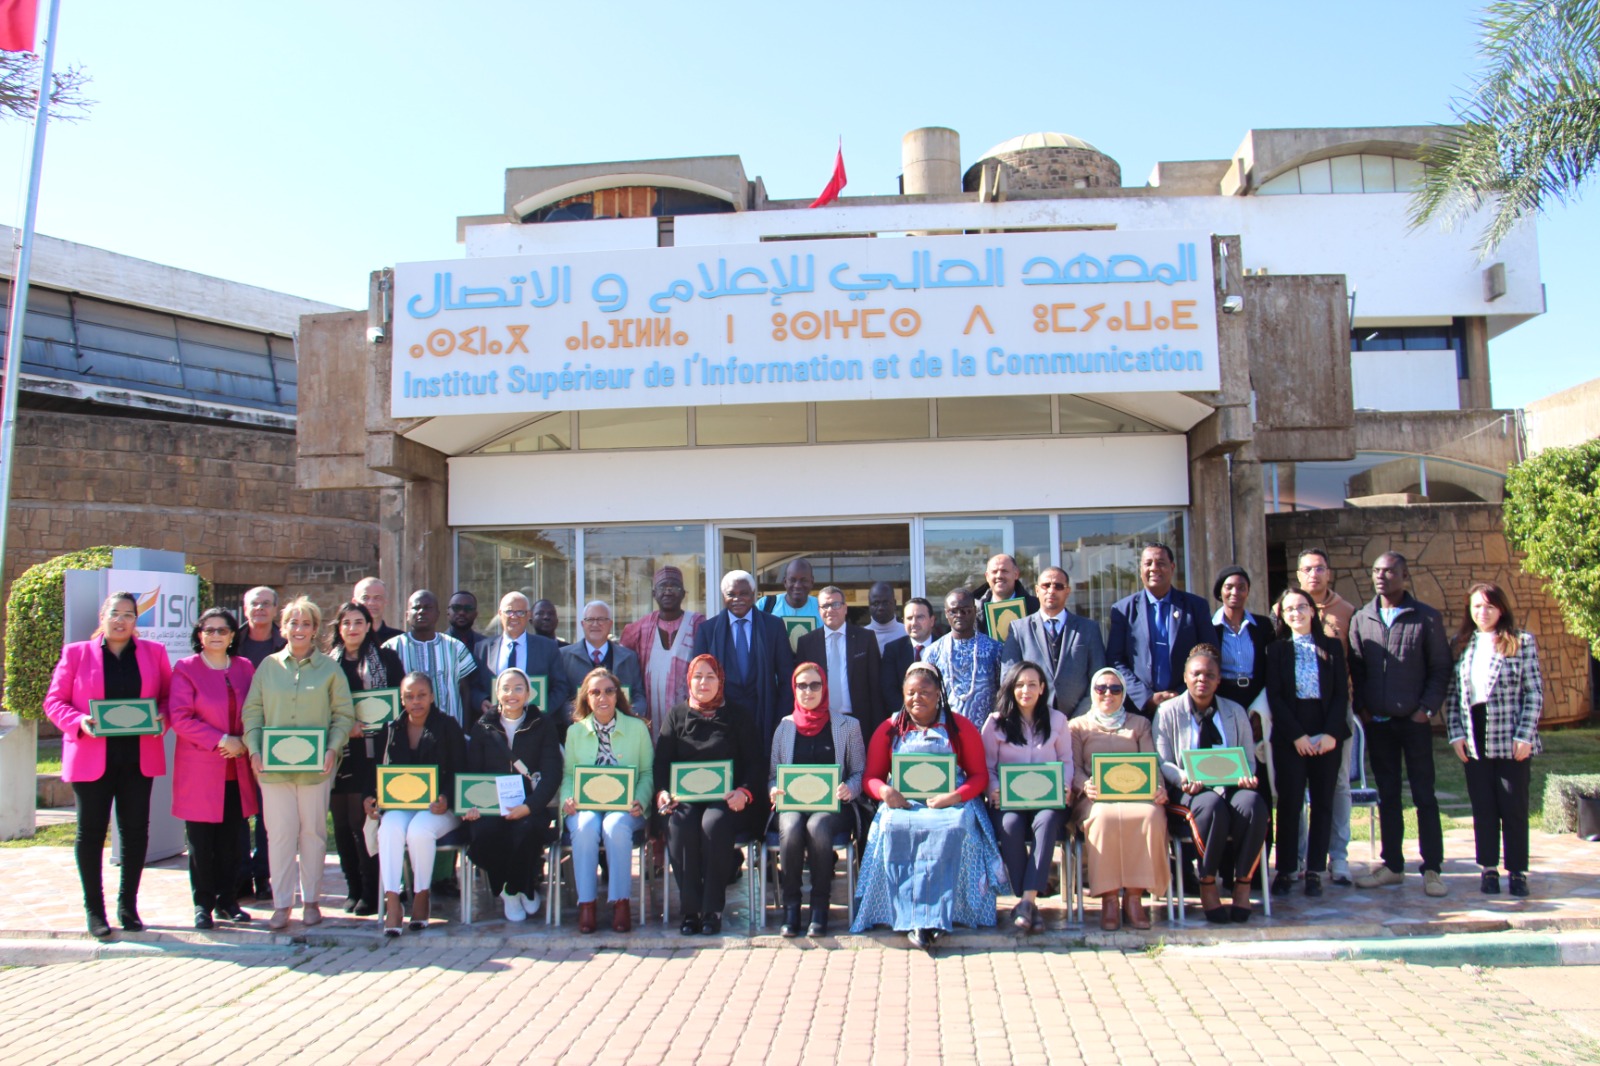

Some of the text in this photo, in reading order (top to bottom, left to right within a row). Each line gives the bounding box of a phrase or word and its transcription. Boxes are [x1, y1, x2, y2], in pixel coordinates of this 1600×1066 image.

[405, 242, 1199, 319] المعهد العالي للإعلام و الاتصال
[403, 343, 1203, 400] Institut Supérieur de l'Information et de la Communication
[160, 594, 197, 628] ISIC
